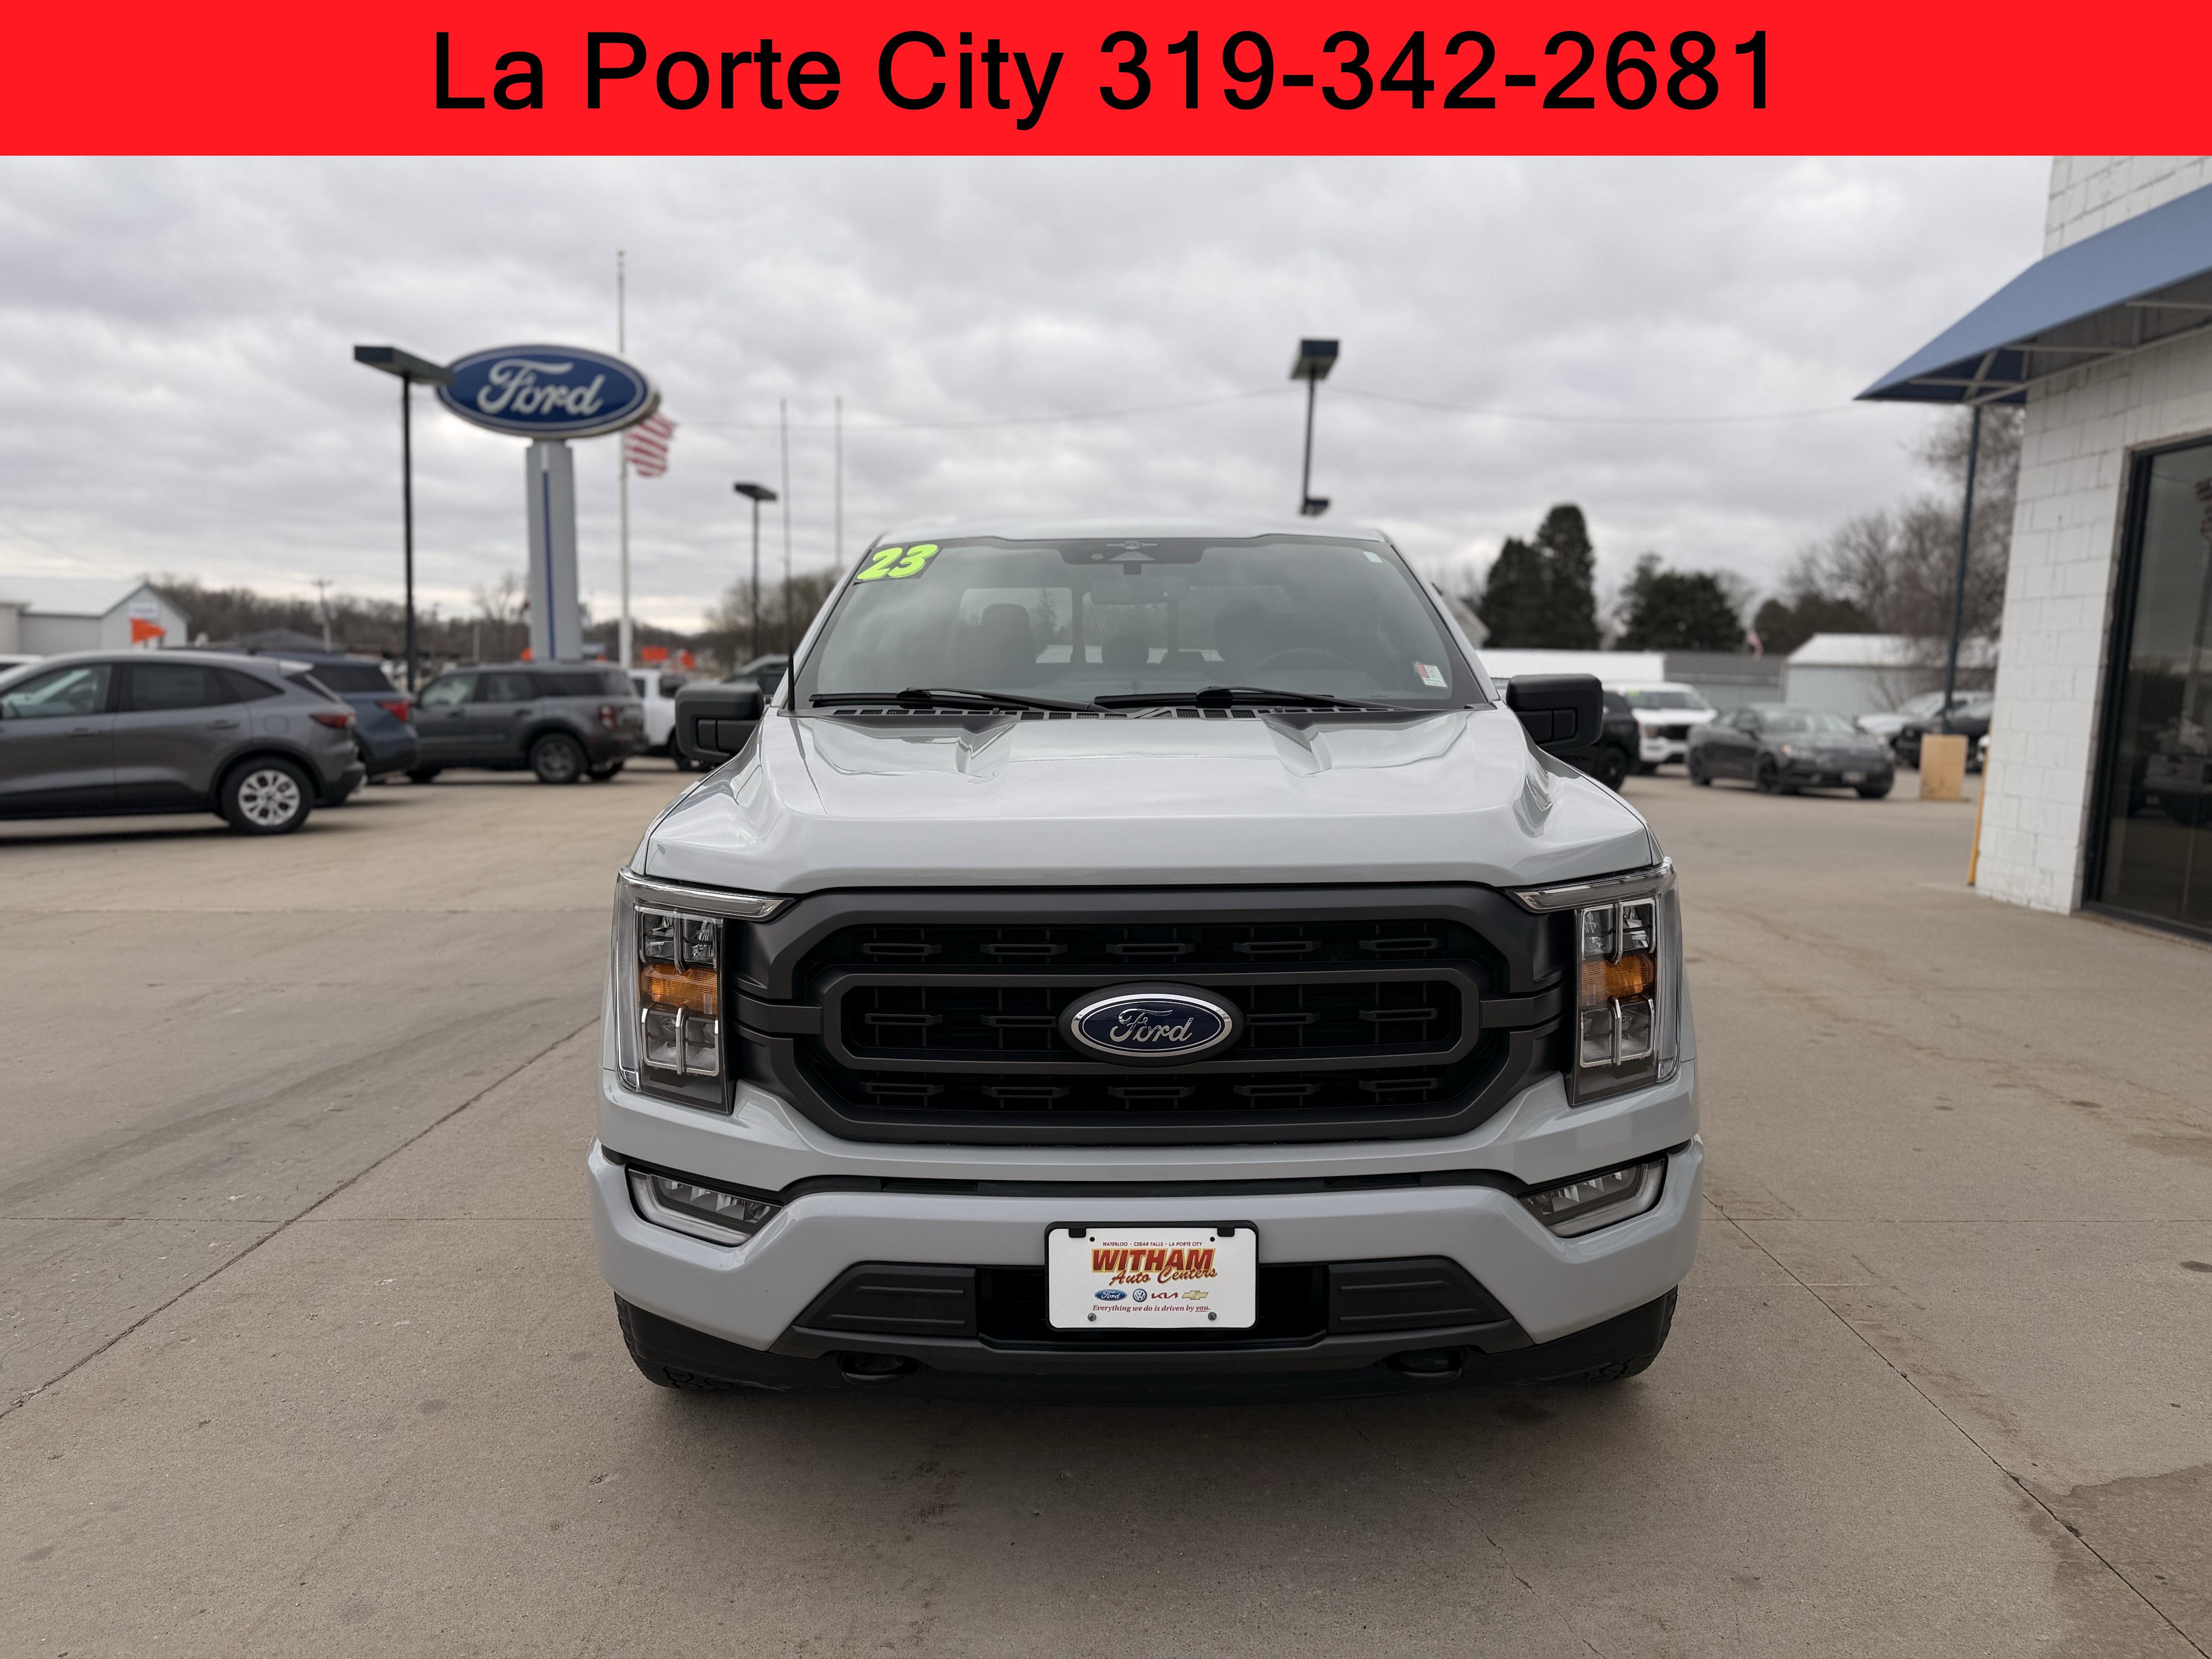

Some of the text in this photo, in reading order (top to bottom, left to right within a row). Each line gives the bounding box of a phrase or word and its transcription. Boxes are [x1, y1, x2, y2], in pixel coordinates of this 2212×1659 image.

[477, 359, 606, 415] Ford
[857, 544, 939, 580] 23
[1110, 1008, 1194, 1042] Ford
[1092, 1248, 1216, 1273] WITHAM
[1109, 1266, 1218, 1286] Auto Centers
